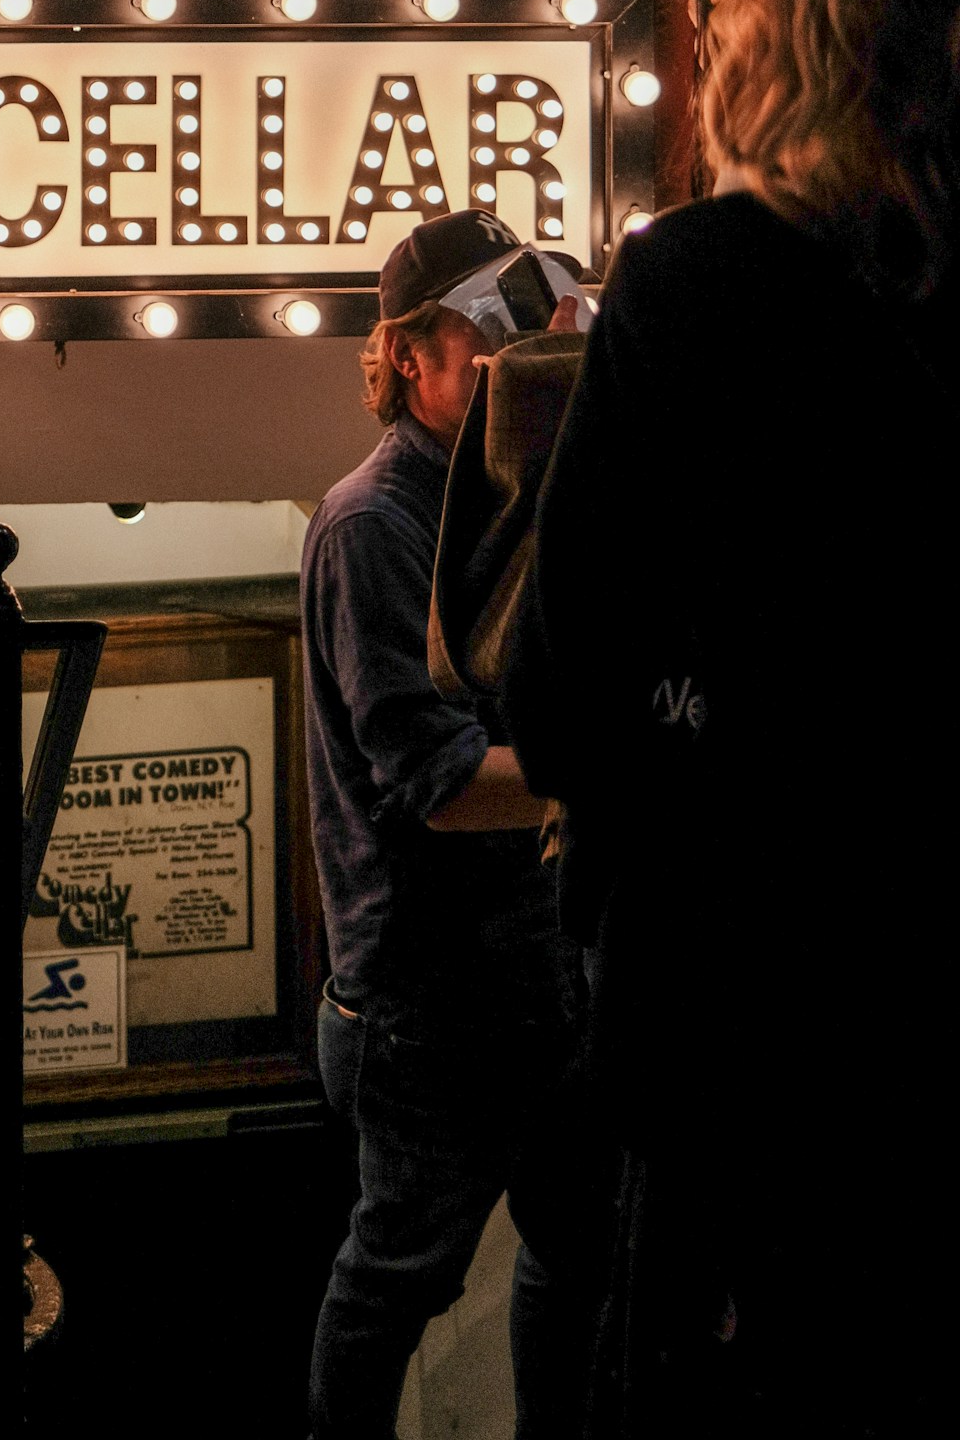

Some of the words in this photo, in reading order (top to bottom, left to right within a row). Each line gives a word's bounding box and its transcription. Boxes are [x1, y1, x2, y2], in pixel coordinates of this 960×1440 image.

[67, 763, 123, 786] BEST
[132, 756, 237, 781] COMEDY
[60, 789, 112, 811] OOM
[119, 786, 143, 807] IN
